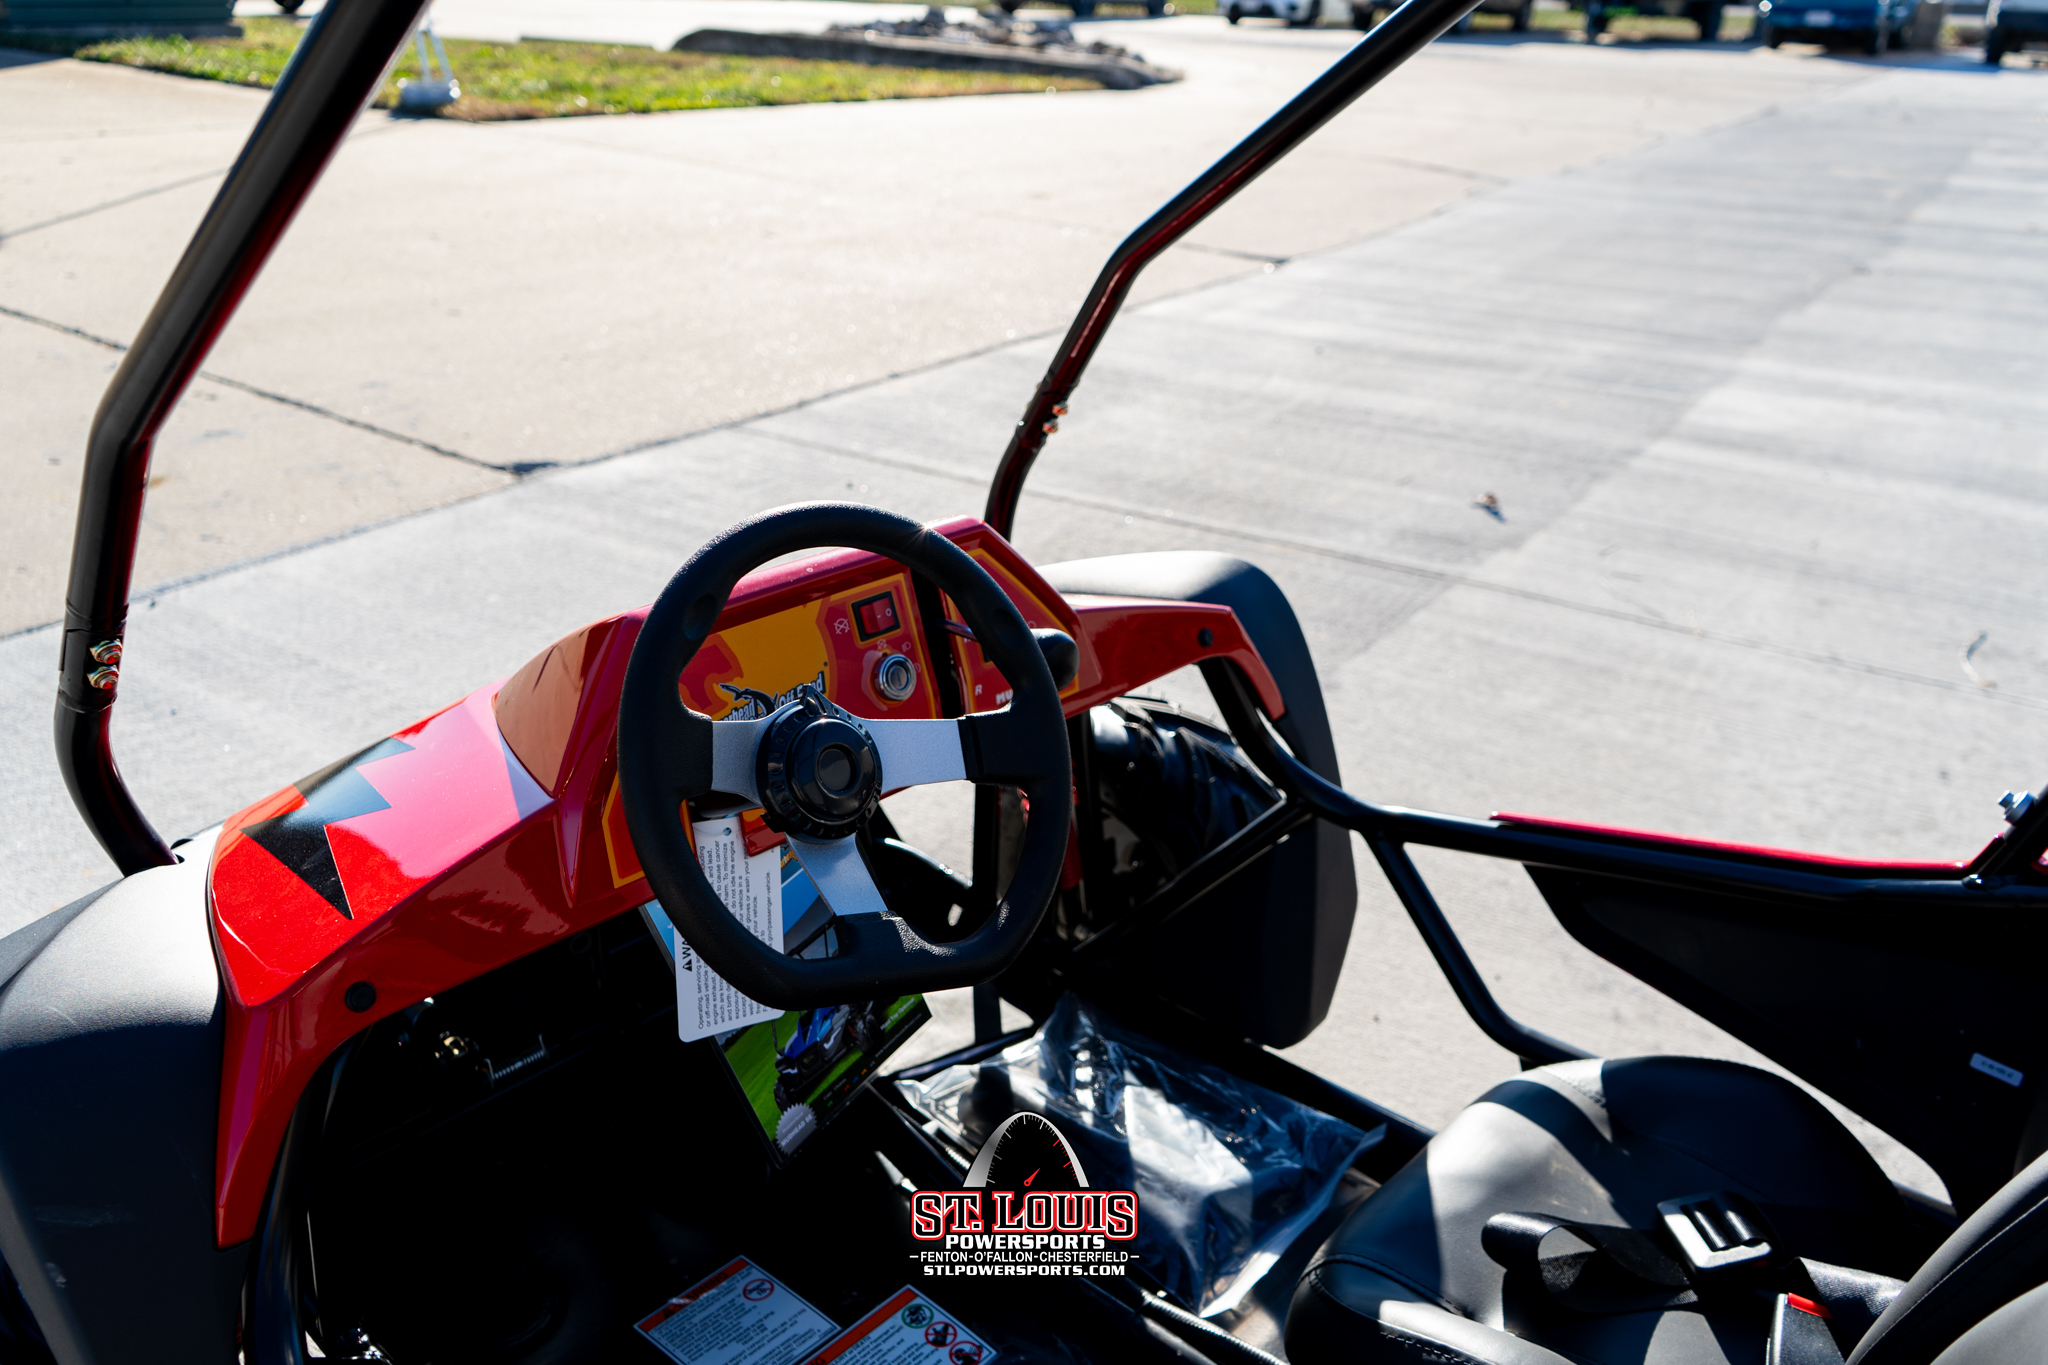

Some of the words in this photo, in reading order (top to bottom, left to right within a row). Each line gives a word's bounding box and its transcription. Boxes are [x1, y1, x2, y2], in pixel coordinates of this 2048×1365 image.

[722, 873, 728, 881] To
[731, 900, 736, 909] do
[780, 1120, 806, 1147] MUDHEAD
